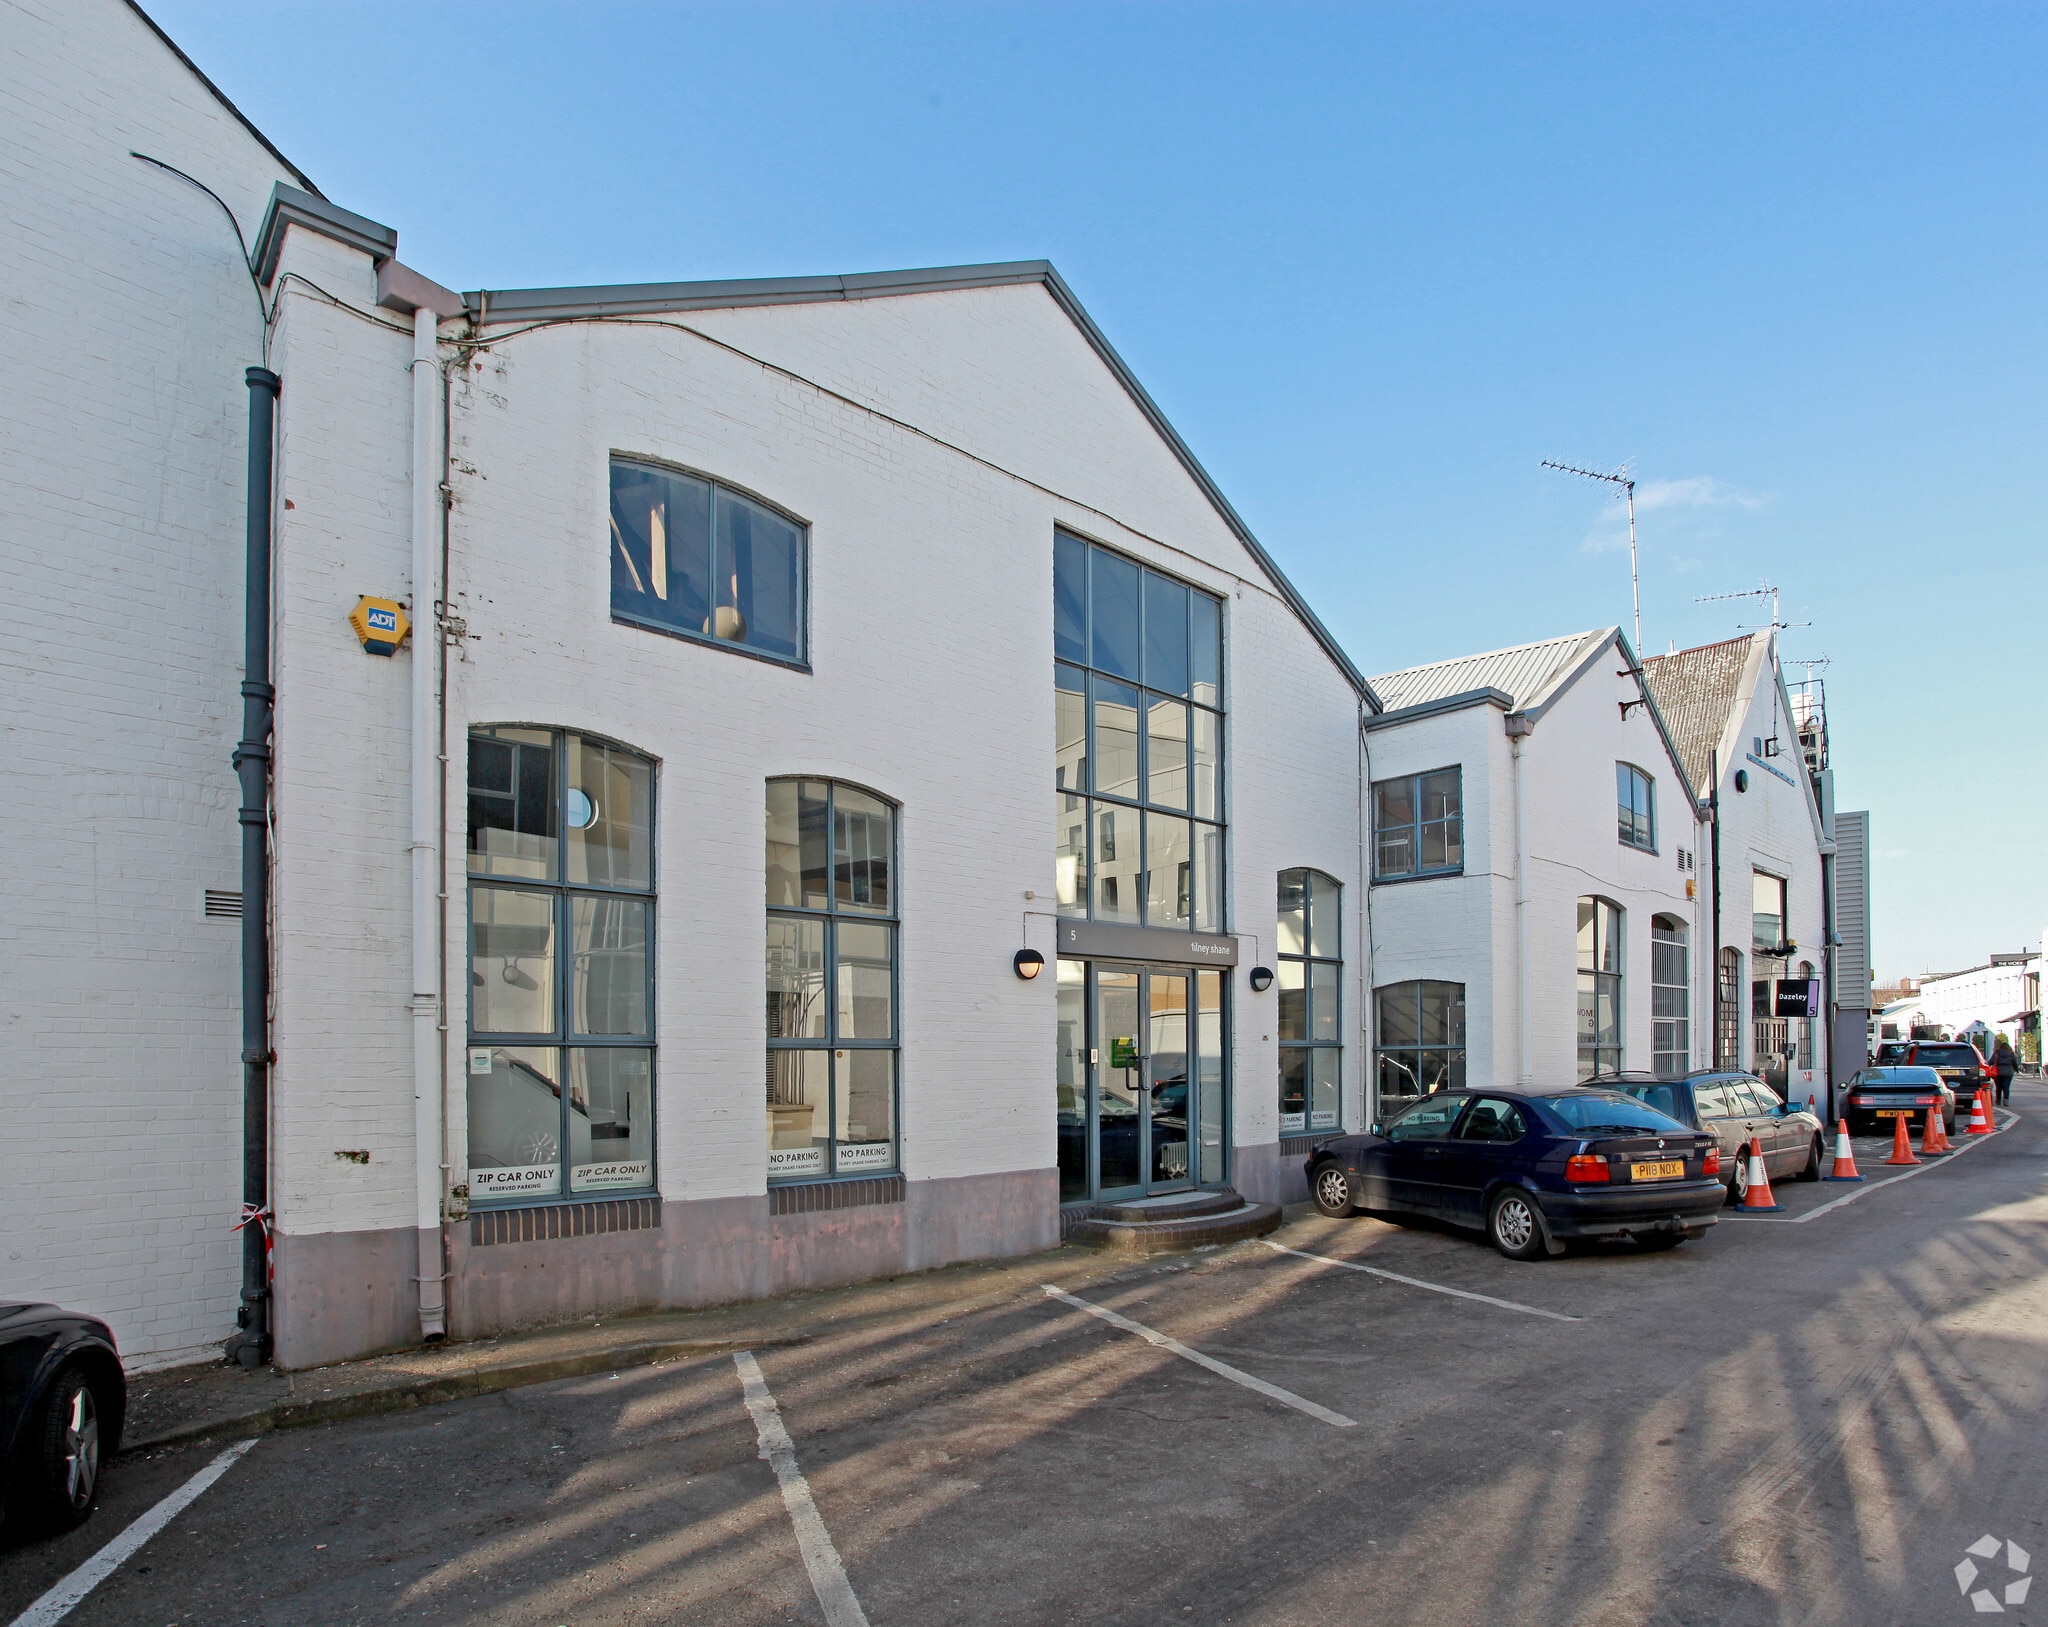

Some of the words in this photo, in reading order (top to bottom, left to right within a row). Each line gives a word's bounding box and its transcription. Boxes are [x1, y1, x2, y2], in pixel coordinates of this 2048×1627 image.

[368, 613, 396, 628] ADT
[1070, 930, 1076, 941] 5
[1191, 942, 1210, 955] tilney
[1210, 944, 1230, 954] shane
[1778, 993, 1807, 1001] Dazeley
[1808, 1006, 1816, 1015] 5
[770, 1154, 784, 1163] NO
[786, 1152, 819, 1162] PARKING
[841, 1150, 854, 1159] NO
[856, 1147, 887, 1157] PARKING
[577, 1169, 592, 1178] ZIP
[594, 1166, 617, 1175] CAR
[619, 1164, 648, 1174] ONLY
[1659, 1162, 1677, 1175] NOX
[477, 1173, 494, 1183] ZIP
[497, 1172, 522, 1182] CAR
[525, 1169, 555, 1180] ONLY
